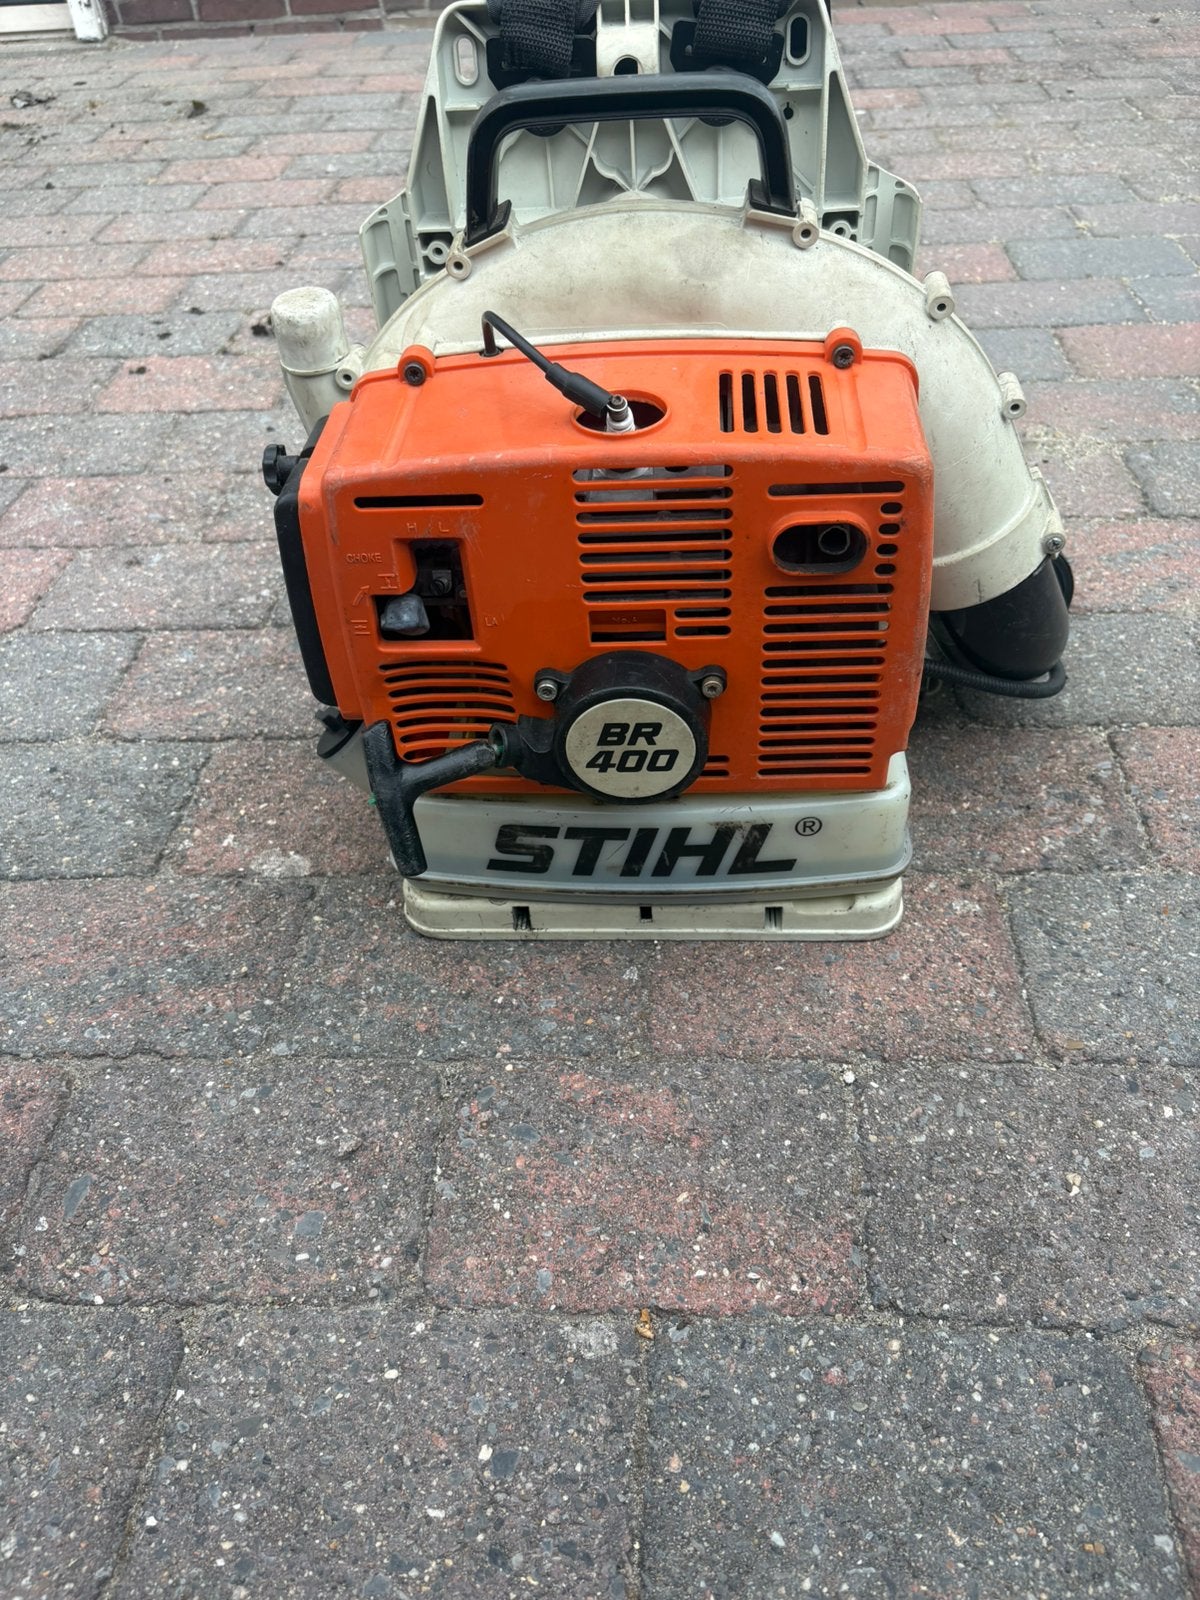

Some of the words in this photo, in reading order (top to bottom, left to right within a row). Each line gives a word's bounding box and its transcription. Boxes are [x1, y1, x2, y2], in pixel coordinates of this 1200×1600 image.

[406, 522, 417, 533] H
[438, 521, 450, 532] L
[345, 552, 383, 564] CHOKE
[484, 616, 499, 627] LA
[597, 722, 663, 747] BR
[585, 749, 680, 774] 400
[486, 823, 798, 878] STIHL
